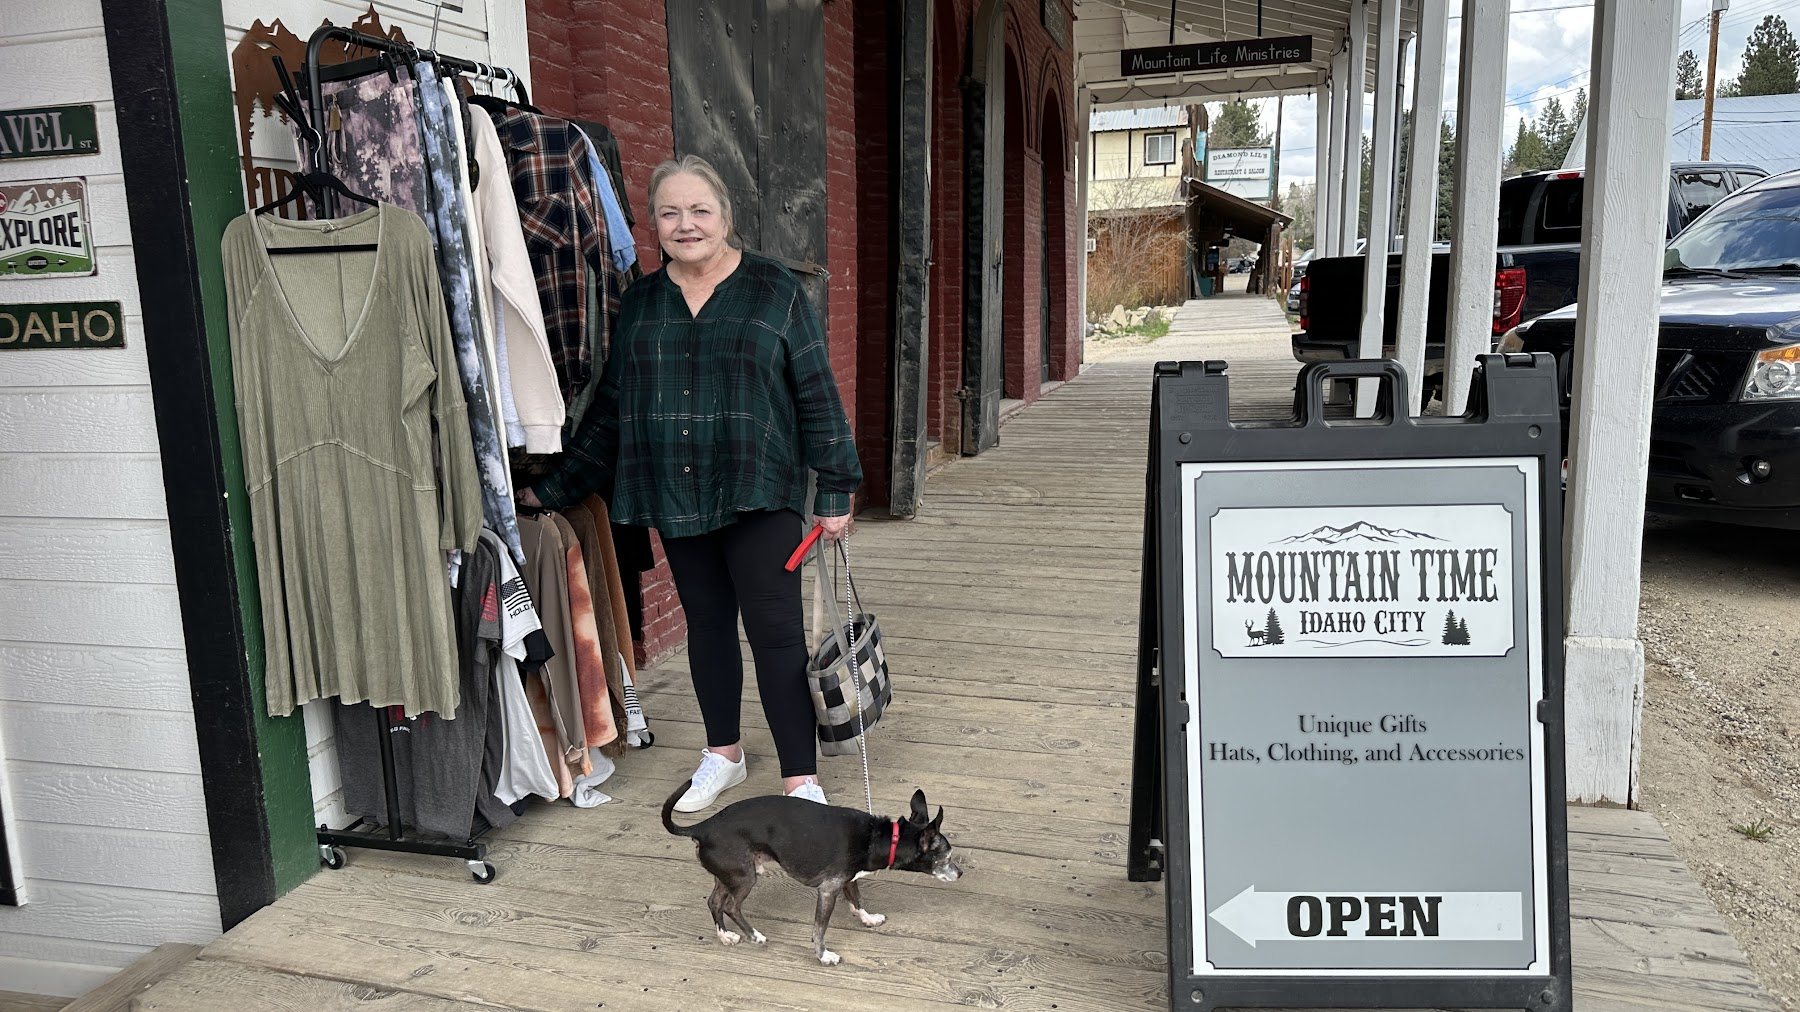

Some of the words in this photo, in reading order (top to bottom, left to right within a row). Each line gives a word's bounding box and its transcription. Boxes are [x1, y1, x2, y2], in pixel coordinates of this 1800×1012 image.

[1131, 52, 1191, 71] Mountain
[1197, 47, 1228, 65] Life
[1235, 44, 1300, 62] Ministries
[80, 140, 92, 149] ST
[1212, 151, 1249, 161] DIAMOND
[0, 211, 82, 251] XPLORE
[1225, 550, 1400, 604] MOUNTAIN
[1411, 548, 1499, 602] TIME
[509, 603, 530, 619] HOLD
[1300, 610, 1366, 634] IDAHO
[1374, 610, 1426, 635] CITY
[1298, 714, 1373, 737] Unique
[1380, 714, 1427, 733] Gifts
[1209, 742, 1261, 764] Hats,
[1267, 742, 1359, 765] Clothing,
[1365, 742, 1400, 761] and
[1409, 742, 1525, 761] Accessories
[1286, 895, 1443, 938] OPEN
